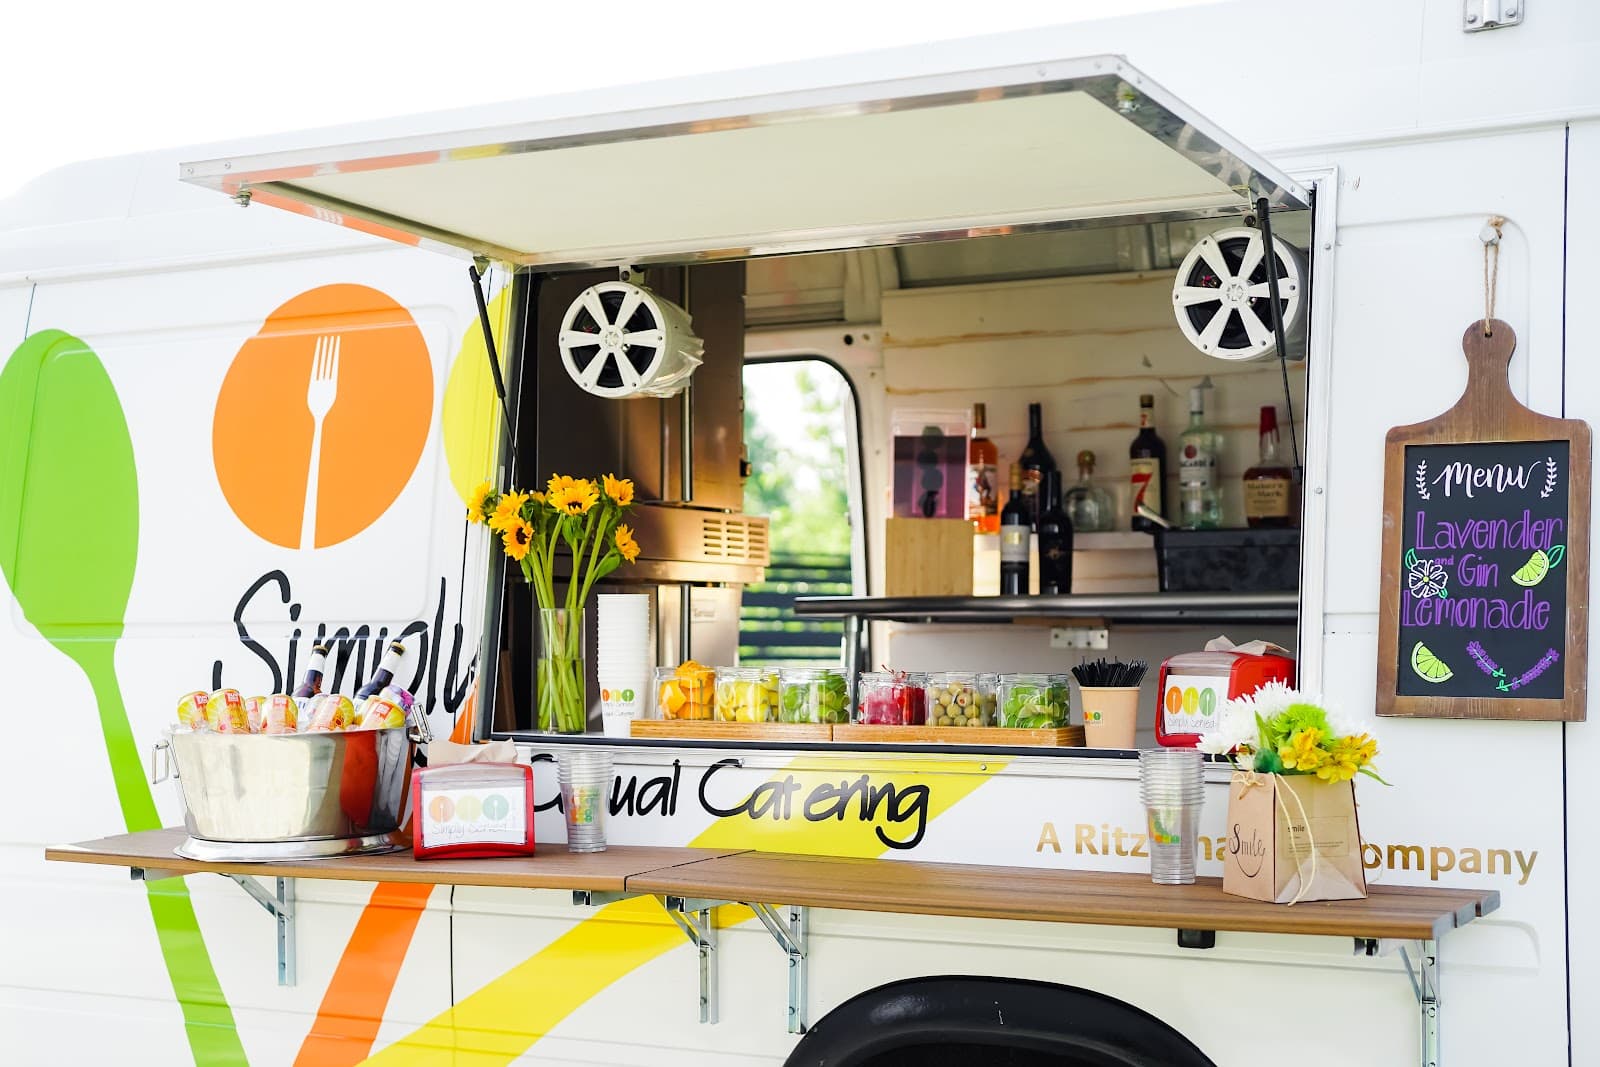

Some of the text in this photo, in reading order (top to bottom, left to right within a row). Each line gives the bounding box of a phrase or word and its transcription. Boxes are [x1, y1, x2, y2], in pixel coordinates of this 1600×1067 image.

[1131, 472, 1153, 513] 7
[1432, 461, 1541, 498] Menu
[1416, 510, 1563, 550] Lavender
[1435, 554, 1499, 588] and Gin
[1402, 589, 1550, 630] Lemonade
[698, 758, 931, 850] Catering
[1036, 822, 1062, 853] A
[1074, 822, 1149, 857] Ritz
[1361, 843, 1538, 886] ompany
[1229, 824, 1266, 858] Smile
